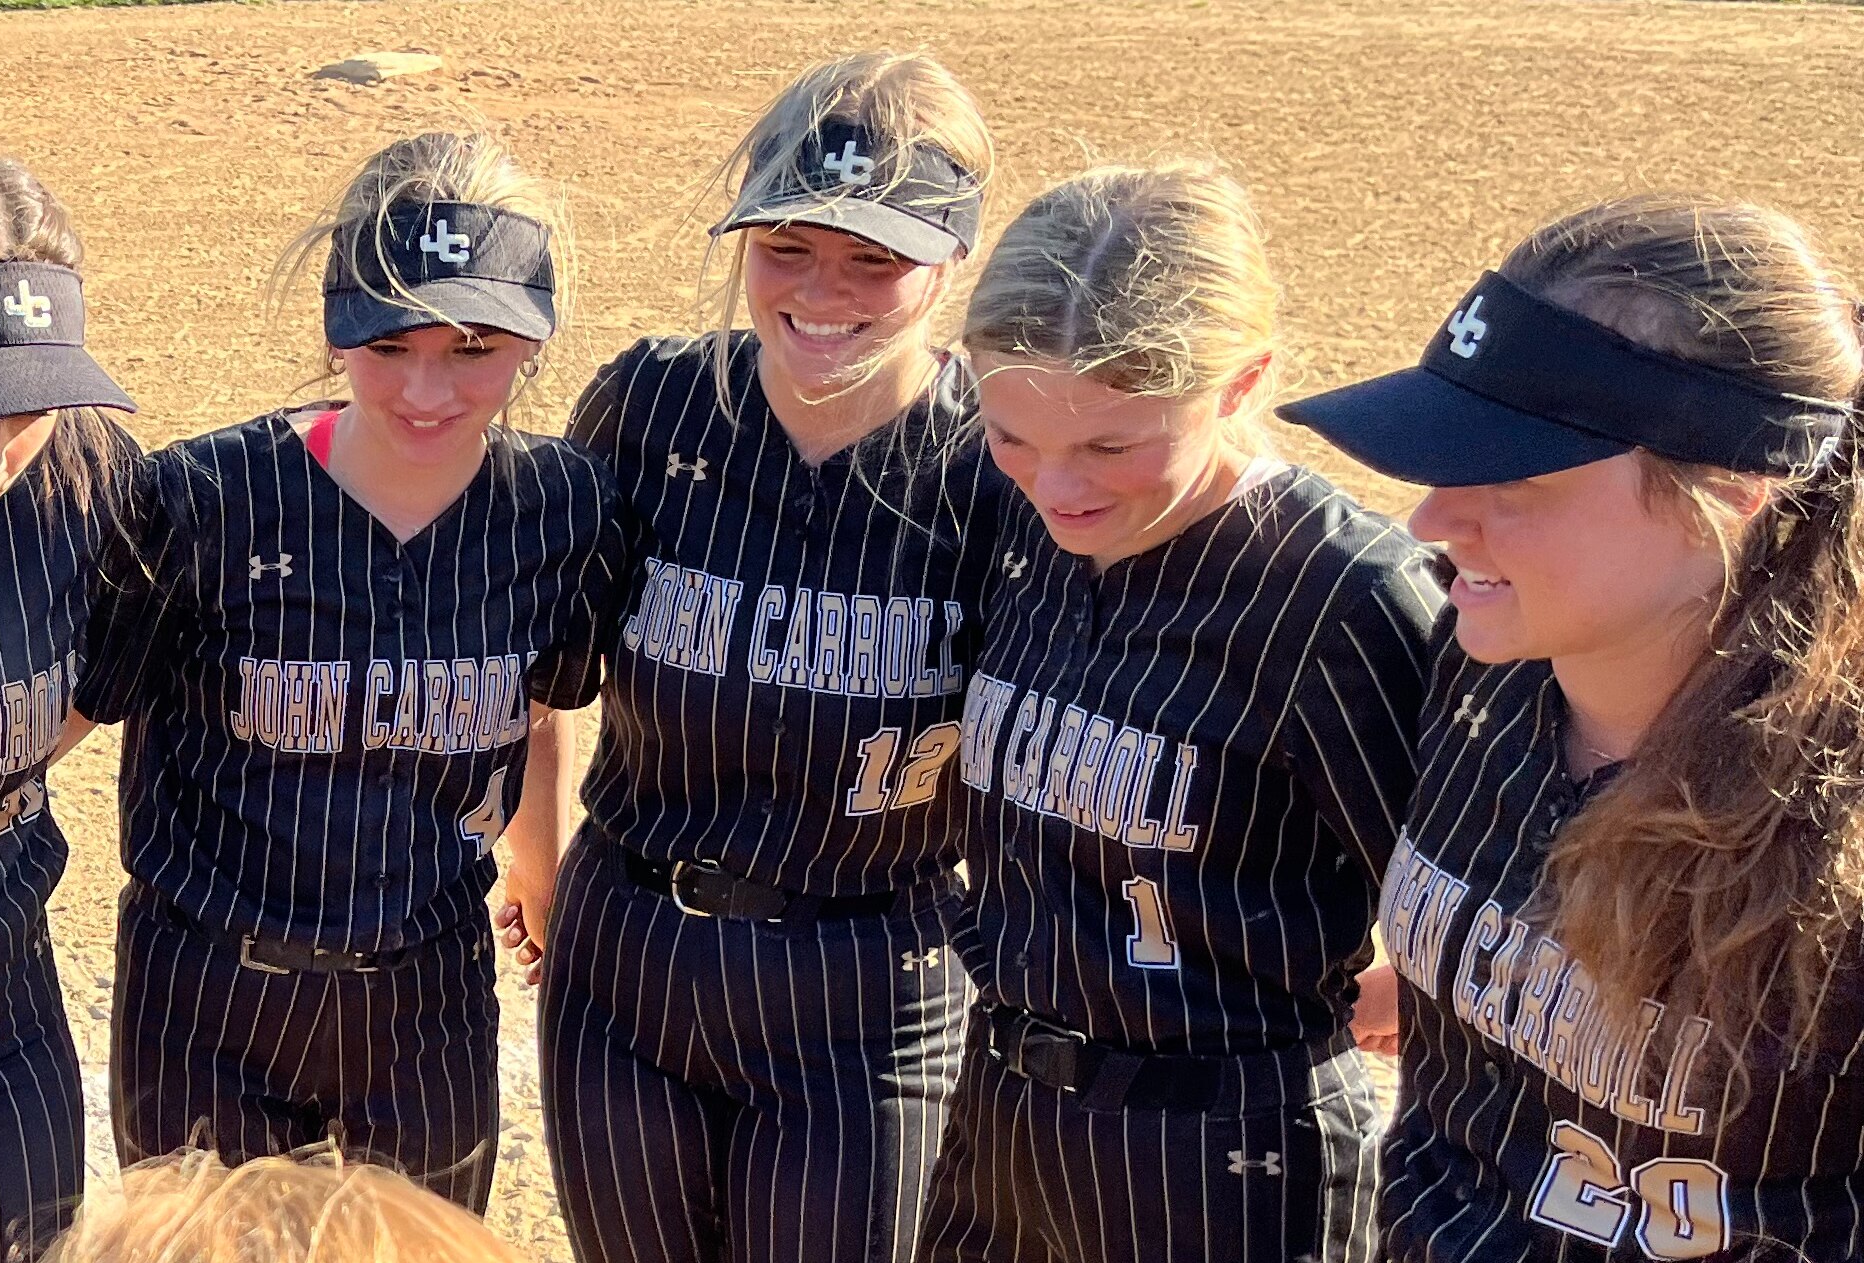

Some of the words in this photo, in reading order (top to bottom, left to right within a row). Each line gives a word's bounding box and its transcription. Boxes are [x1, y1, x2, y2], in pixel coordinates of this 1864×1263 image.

[419, 219, 471, 263] JC
[3, 279, 52, 328] JC
[1447, 295, 1487, 359] JC
[624, 556, 743, 676] JOHN
[747, 584, 964, 699] CARROLL
[230, 656, 350, 754] JOHN
[459, 765, 508, 861] 4
[844, 720, 962, 817] 12
[1001, 690, 1198, 852] CARROLL
[1121, 875, 1179, 970] 1
[1529, 1118, 1732, 1262] 20
